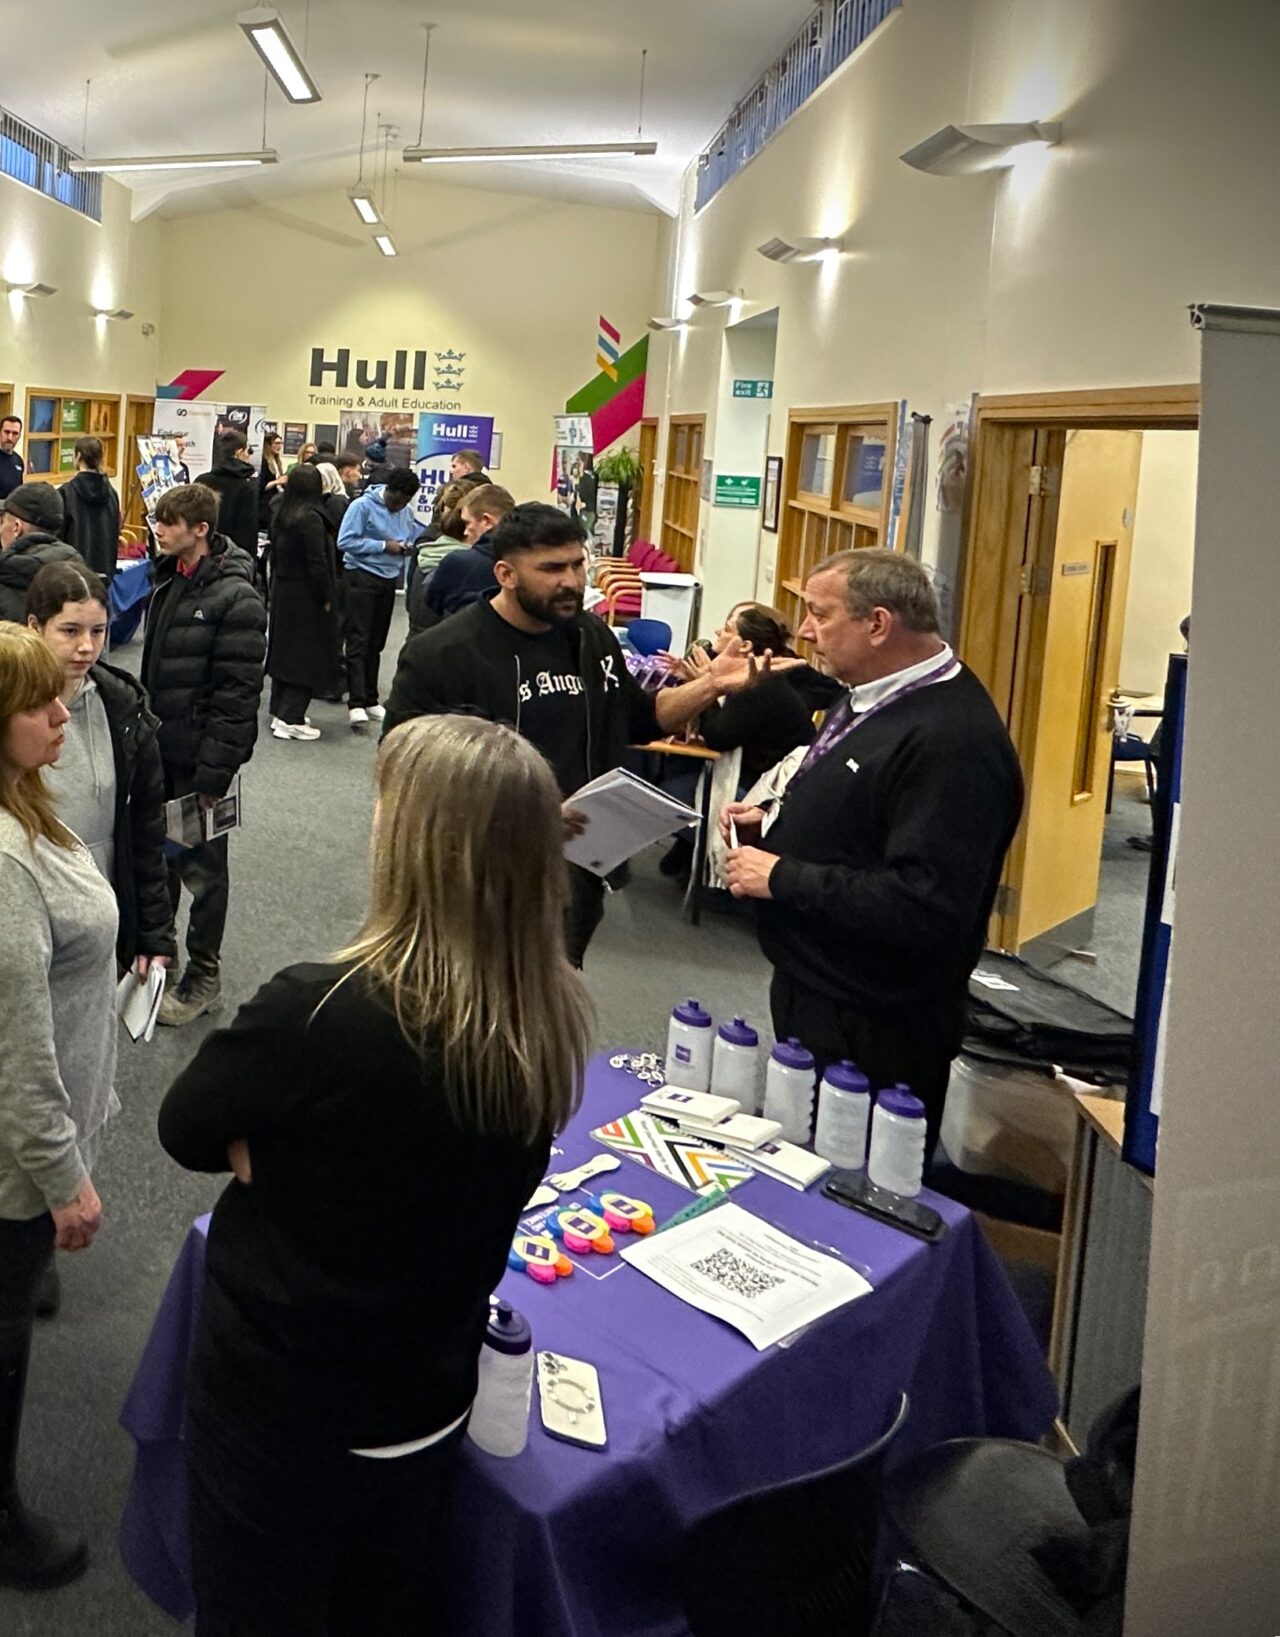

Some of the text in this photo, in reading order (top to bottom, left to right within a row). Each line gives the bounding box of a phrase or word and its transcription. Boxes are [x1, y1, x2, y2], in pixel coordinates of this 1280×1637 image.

[310, 347, 427, 390] Hull
[308, 394, 462, 411] Training & Adult Education
[431, 423, 468, 438] Hull
[420, 469, 453, 485] HU
[421, 486, 436, 494] TR
[417, 505, 432, 513] ED
[520, 680, 532, 702] s
